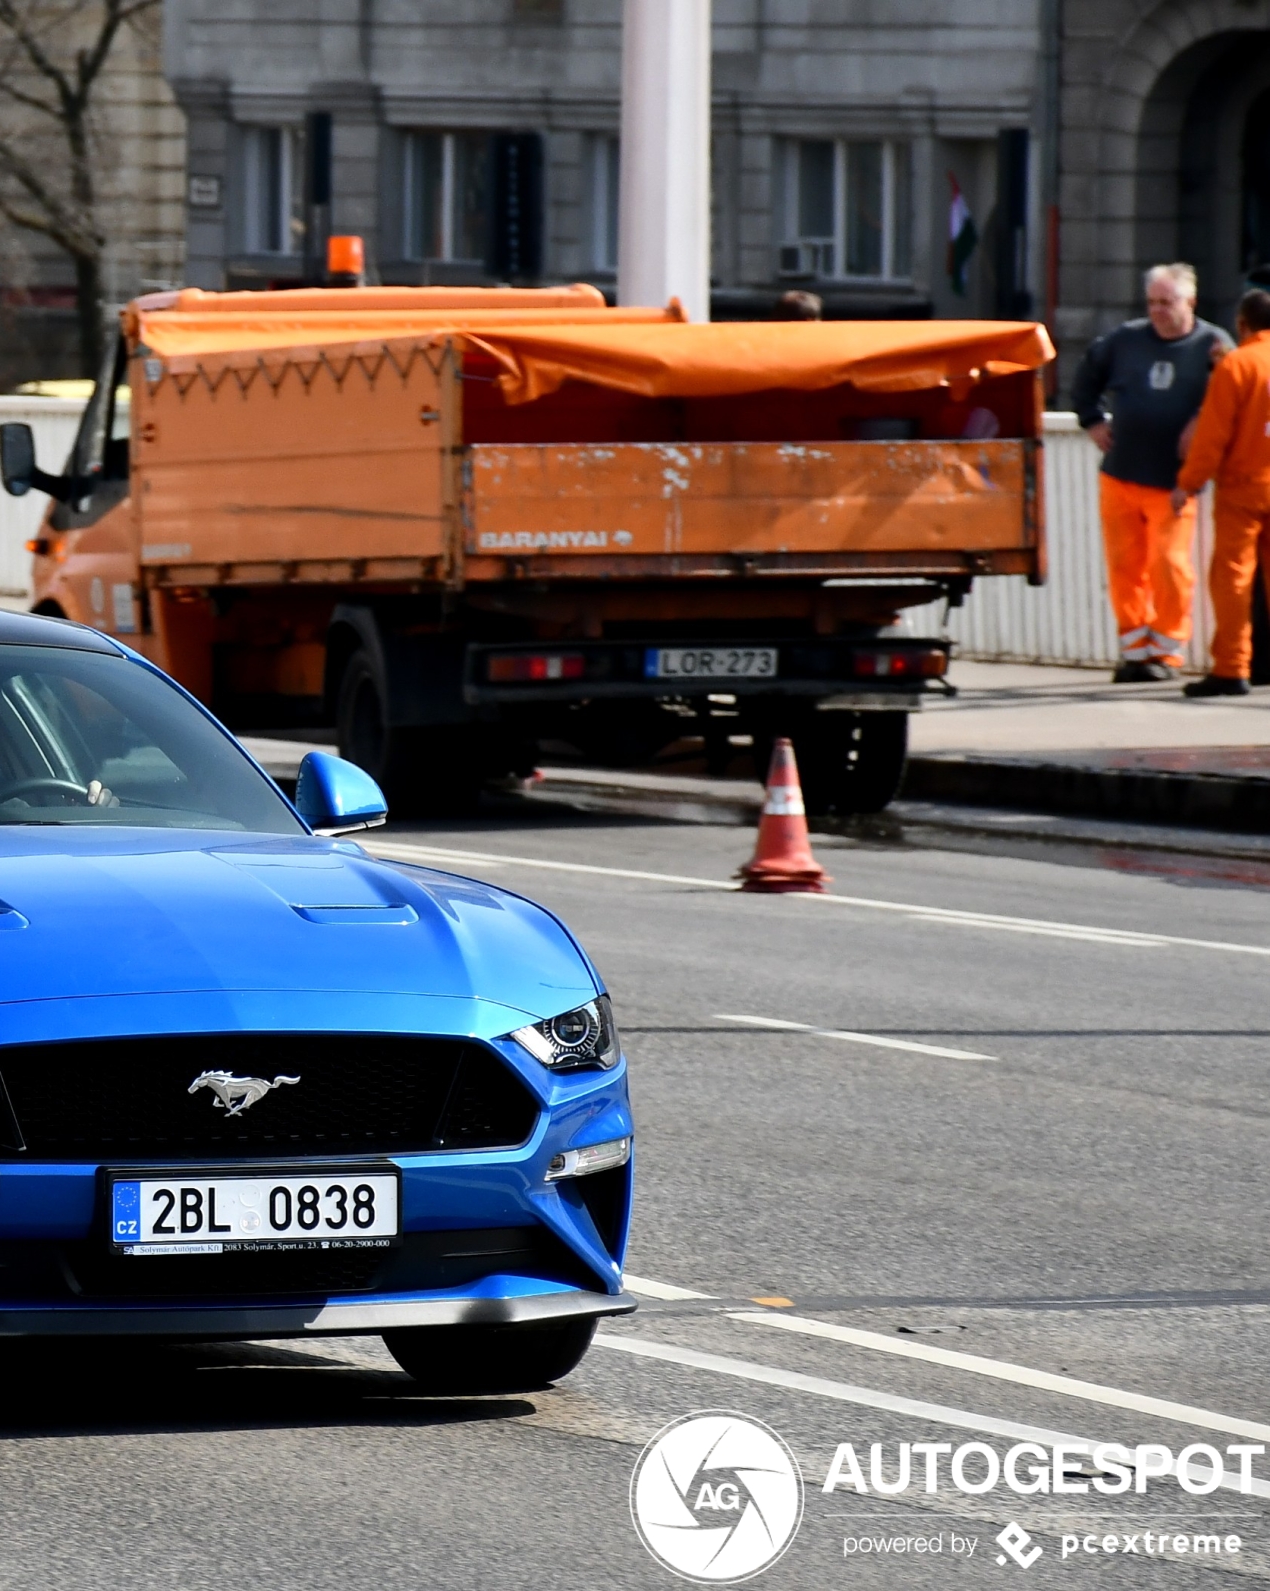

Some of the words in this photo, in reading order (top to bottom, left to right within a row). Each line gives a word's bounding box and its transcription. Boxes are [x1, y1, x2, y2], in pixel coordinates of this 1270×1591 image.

[480, 531, 607, 548] BARANYAI
[661, 651, 772, 674] LOR-273
[152, 1187, 231, 1234] 2BL
[269, 1183, 376, 1231] 0838
[117, 1220, 138, 1234] CZ
[224, 1243, 242, 1251] 2083
[307, 1241, 319, 1249] 23.
[331, 1240, 390, 1248] 06-20-2900-000
